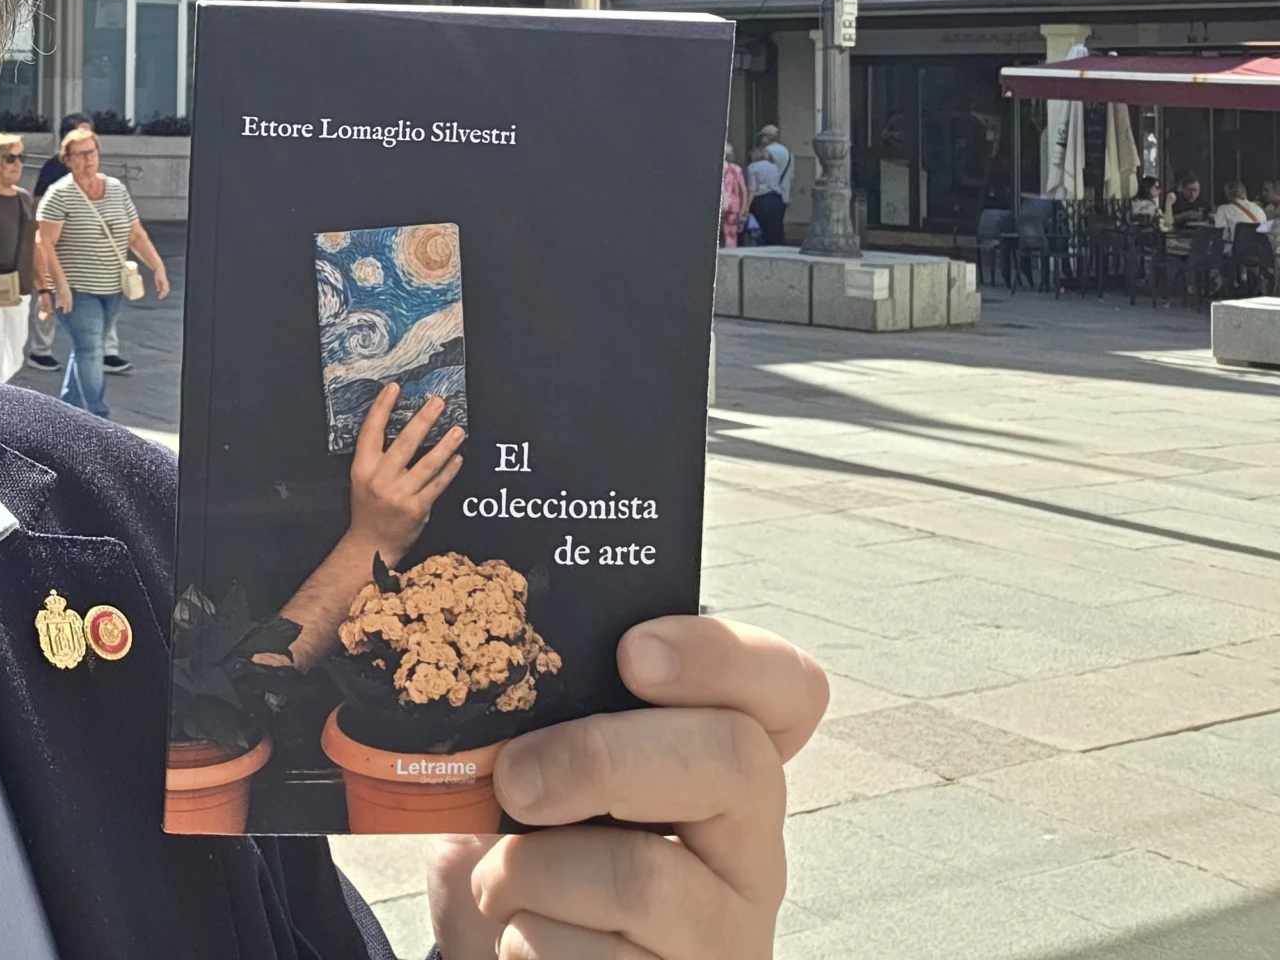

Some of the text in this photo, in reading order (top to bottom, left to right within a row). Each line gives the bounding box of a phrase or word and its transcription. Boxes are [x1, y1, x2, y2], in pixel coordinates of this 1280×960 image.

[241, 115, 517, 148] Ettore Lomaglio Silvestri
[494, 442, 532, 472] El
[462, 488, 659, 520] coleccionista
[554, 535, 657, 566] de arte
[396, 759, 477, 775] Letrame
